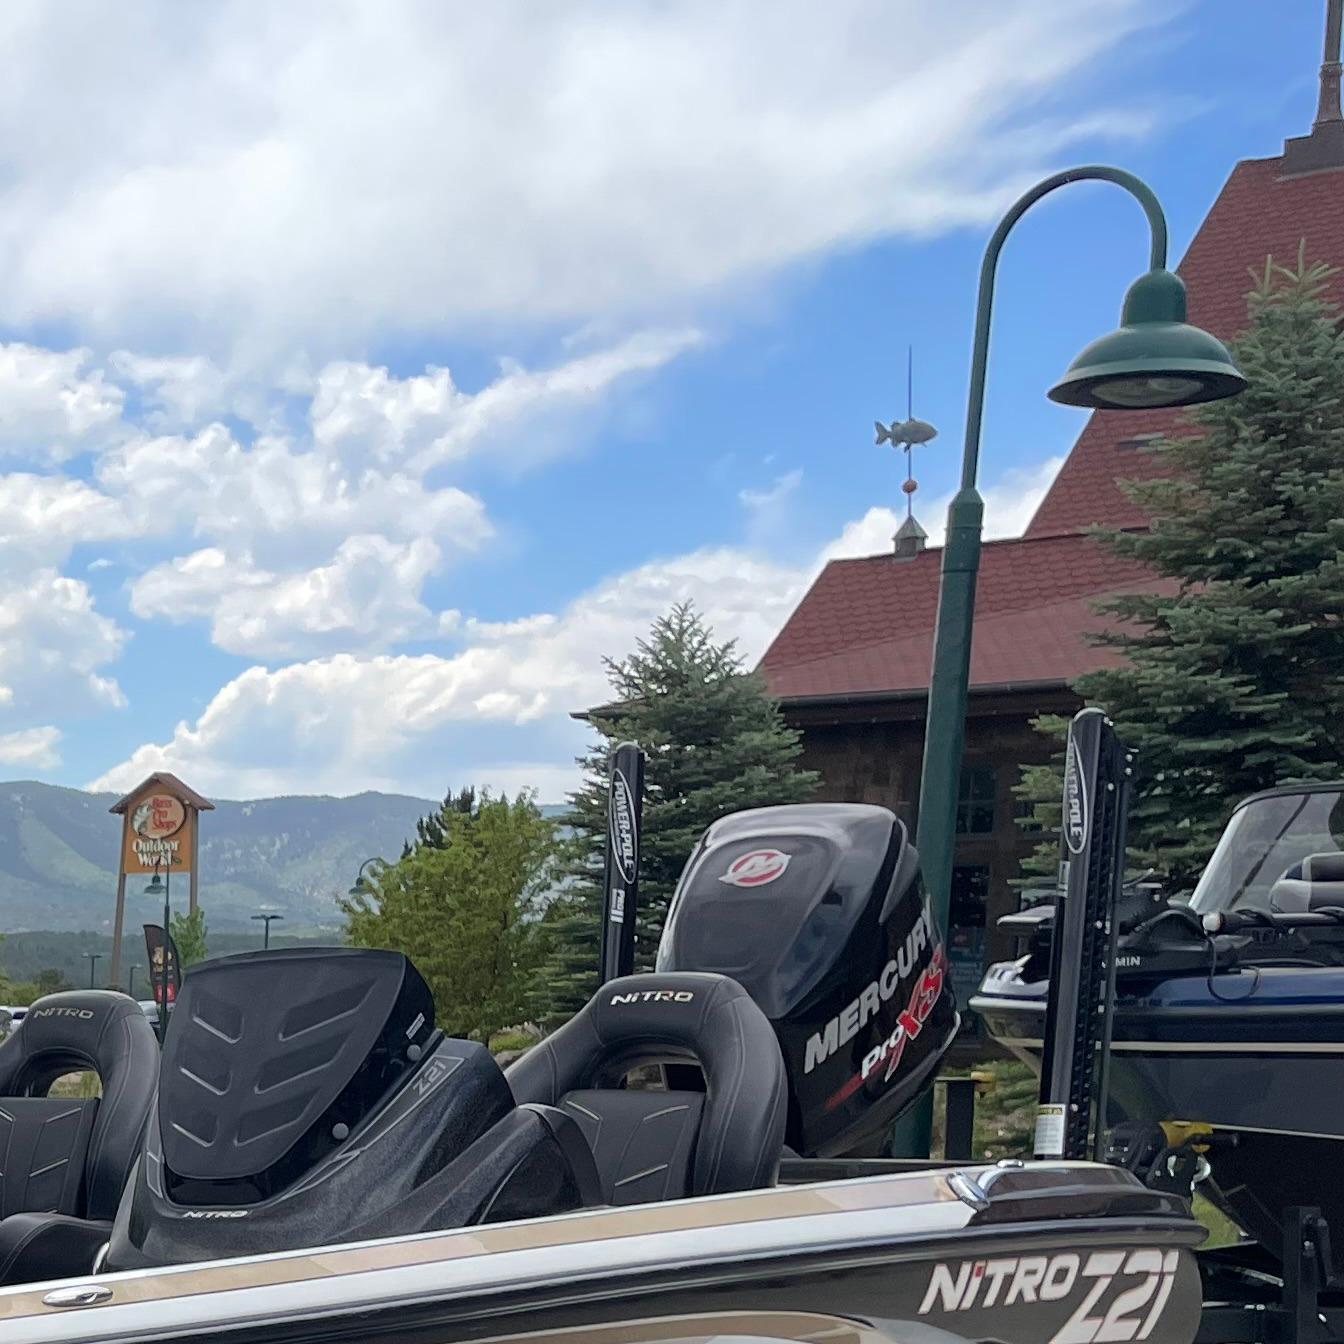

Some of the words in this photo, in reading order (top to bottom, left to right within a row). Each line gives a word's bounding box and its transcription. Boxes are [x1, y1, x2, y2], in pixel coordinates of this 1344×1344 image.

[613, 780, 635, 870] POWER-POLE
[132, 838, 180, 853] Outdoor
[804, 893, 932, 1074] MERCURY
[609, 990, 695, 1006] NITRO
[33, 1006, 94, 1020] NITRO
[412, 1058, 448, 1096] Z21
[182, 1210, 250, 1219] NITRO
[917, 1252, 1081, 1315] NITRO
